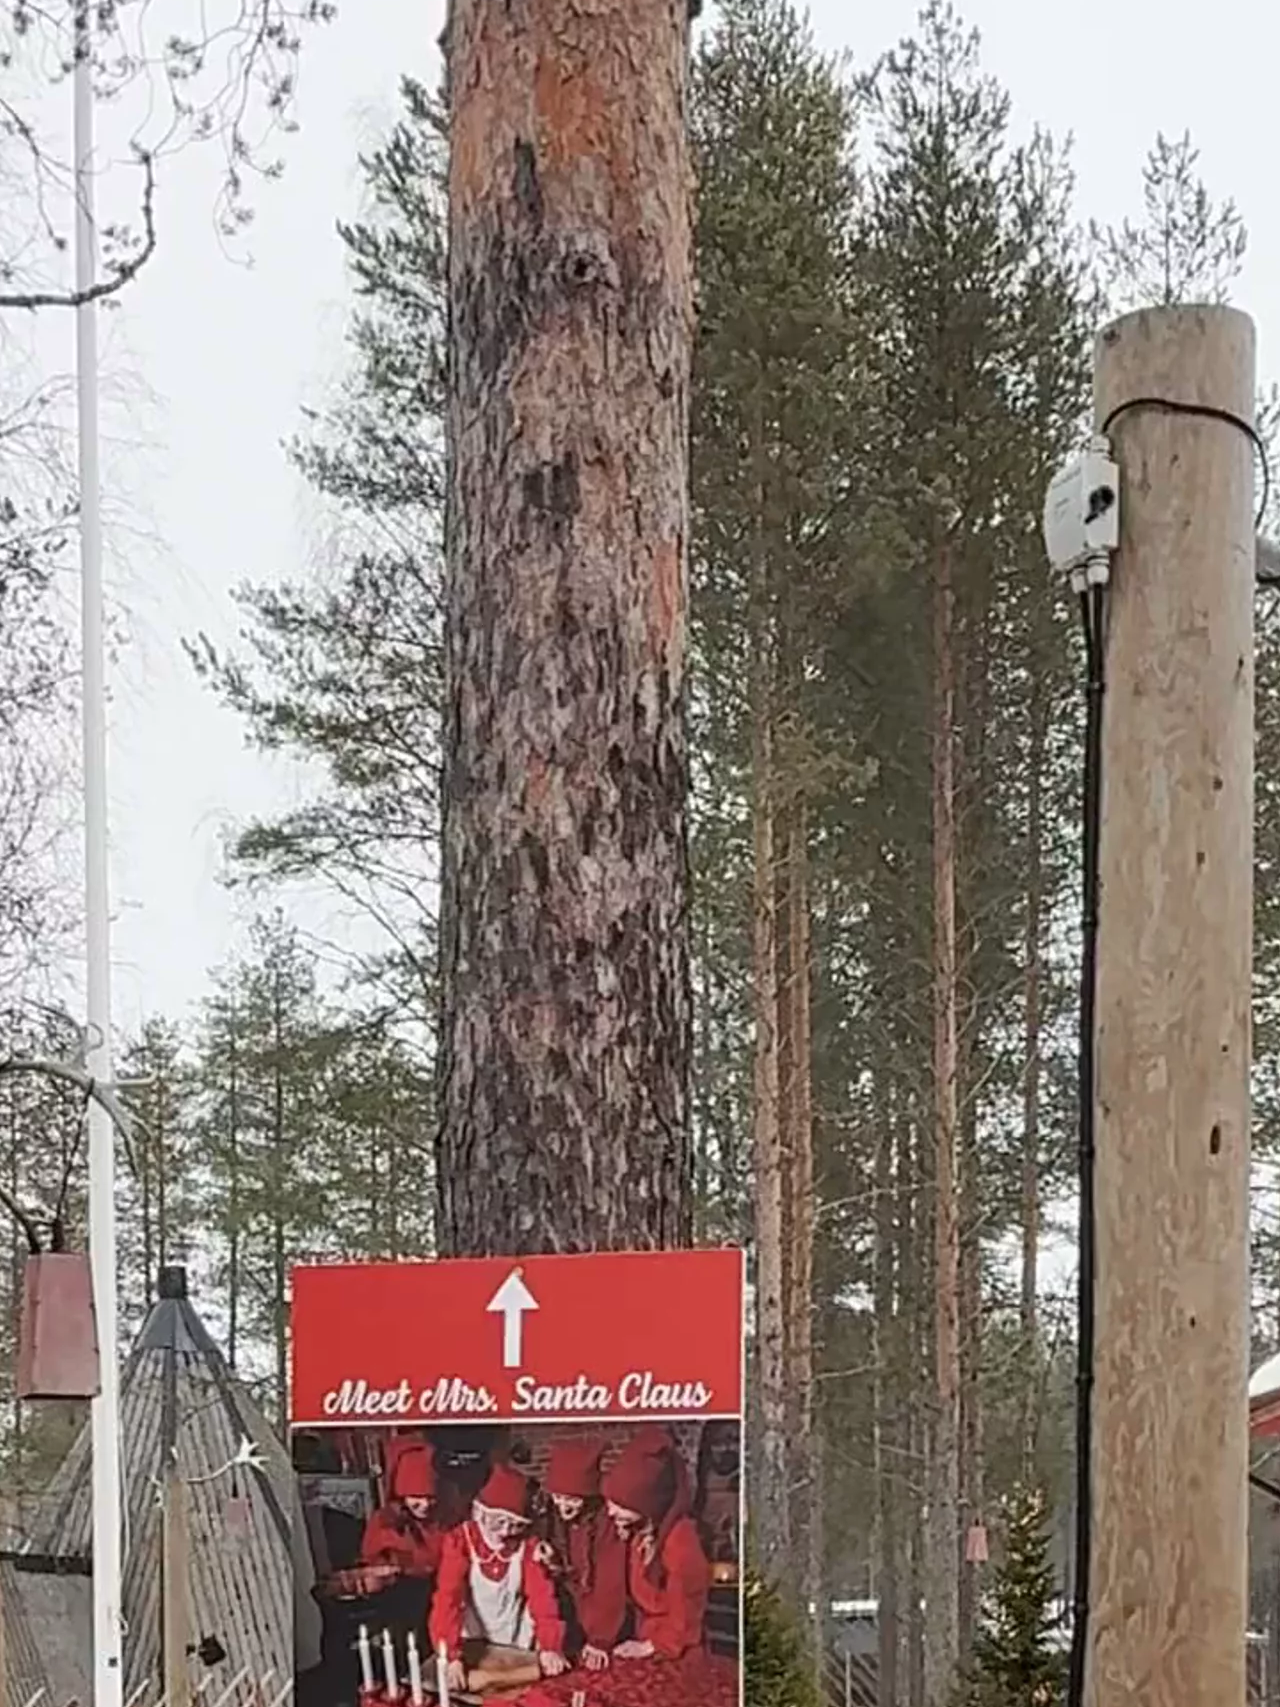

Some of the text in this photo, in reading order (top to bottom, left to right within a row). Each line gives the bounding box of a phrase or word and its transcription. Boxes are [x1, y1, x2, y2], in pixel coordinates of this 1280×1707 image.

[324, 1371, 713, 1415] Meet Mrs. Santa Claus
